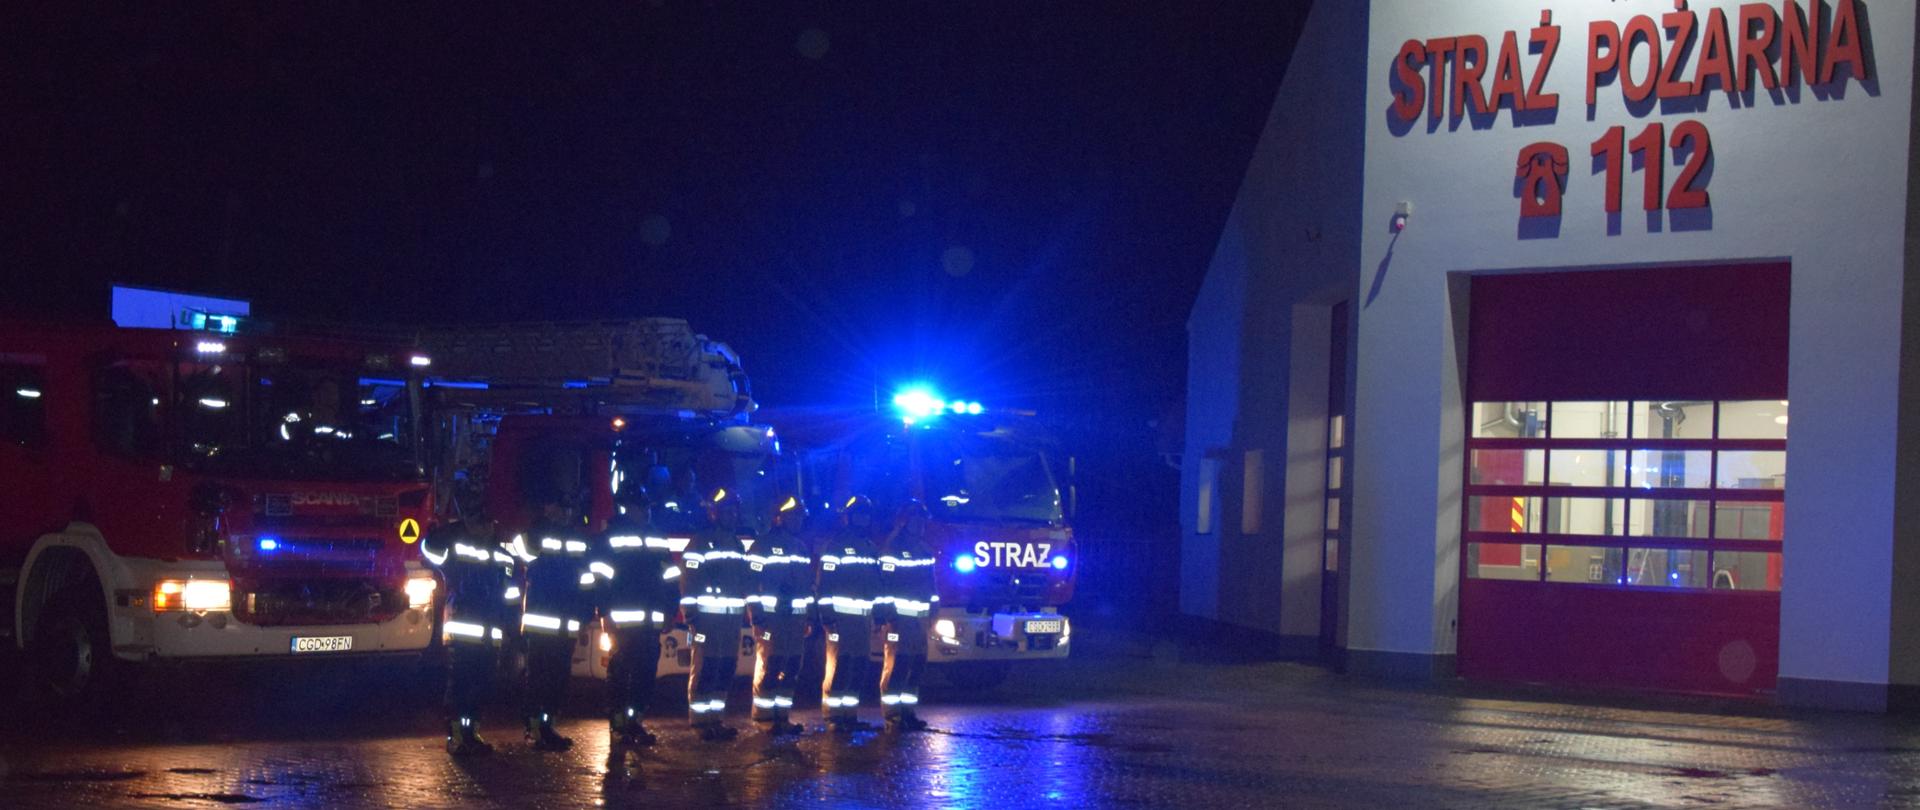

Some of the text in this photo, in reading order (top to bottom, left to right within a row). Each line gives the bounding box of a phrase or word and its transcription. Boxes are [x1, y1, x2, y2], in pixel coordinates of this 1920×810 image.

[1391, 0, 1868, 122] STRAŻ POŻARNA
[1590, 120, 1713, 213] 112
[291, 491, 359, 506] SCANIA
